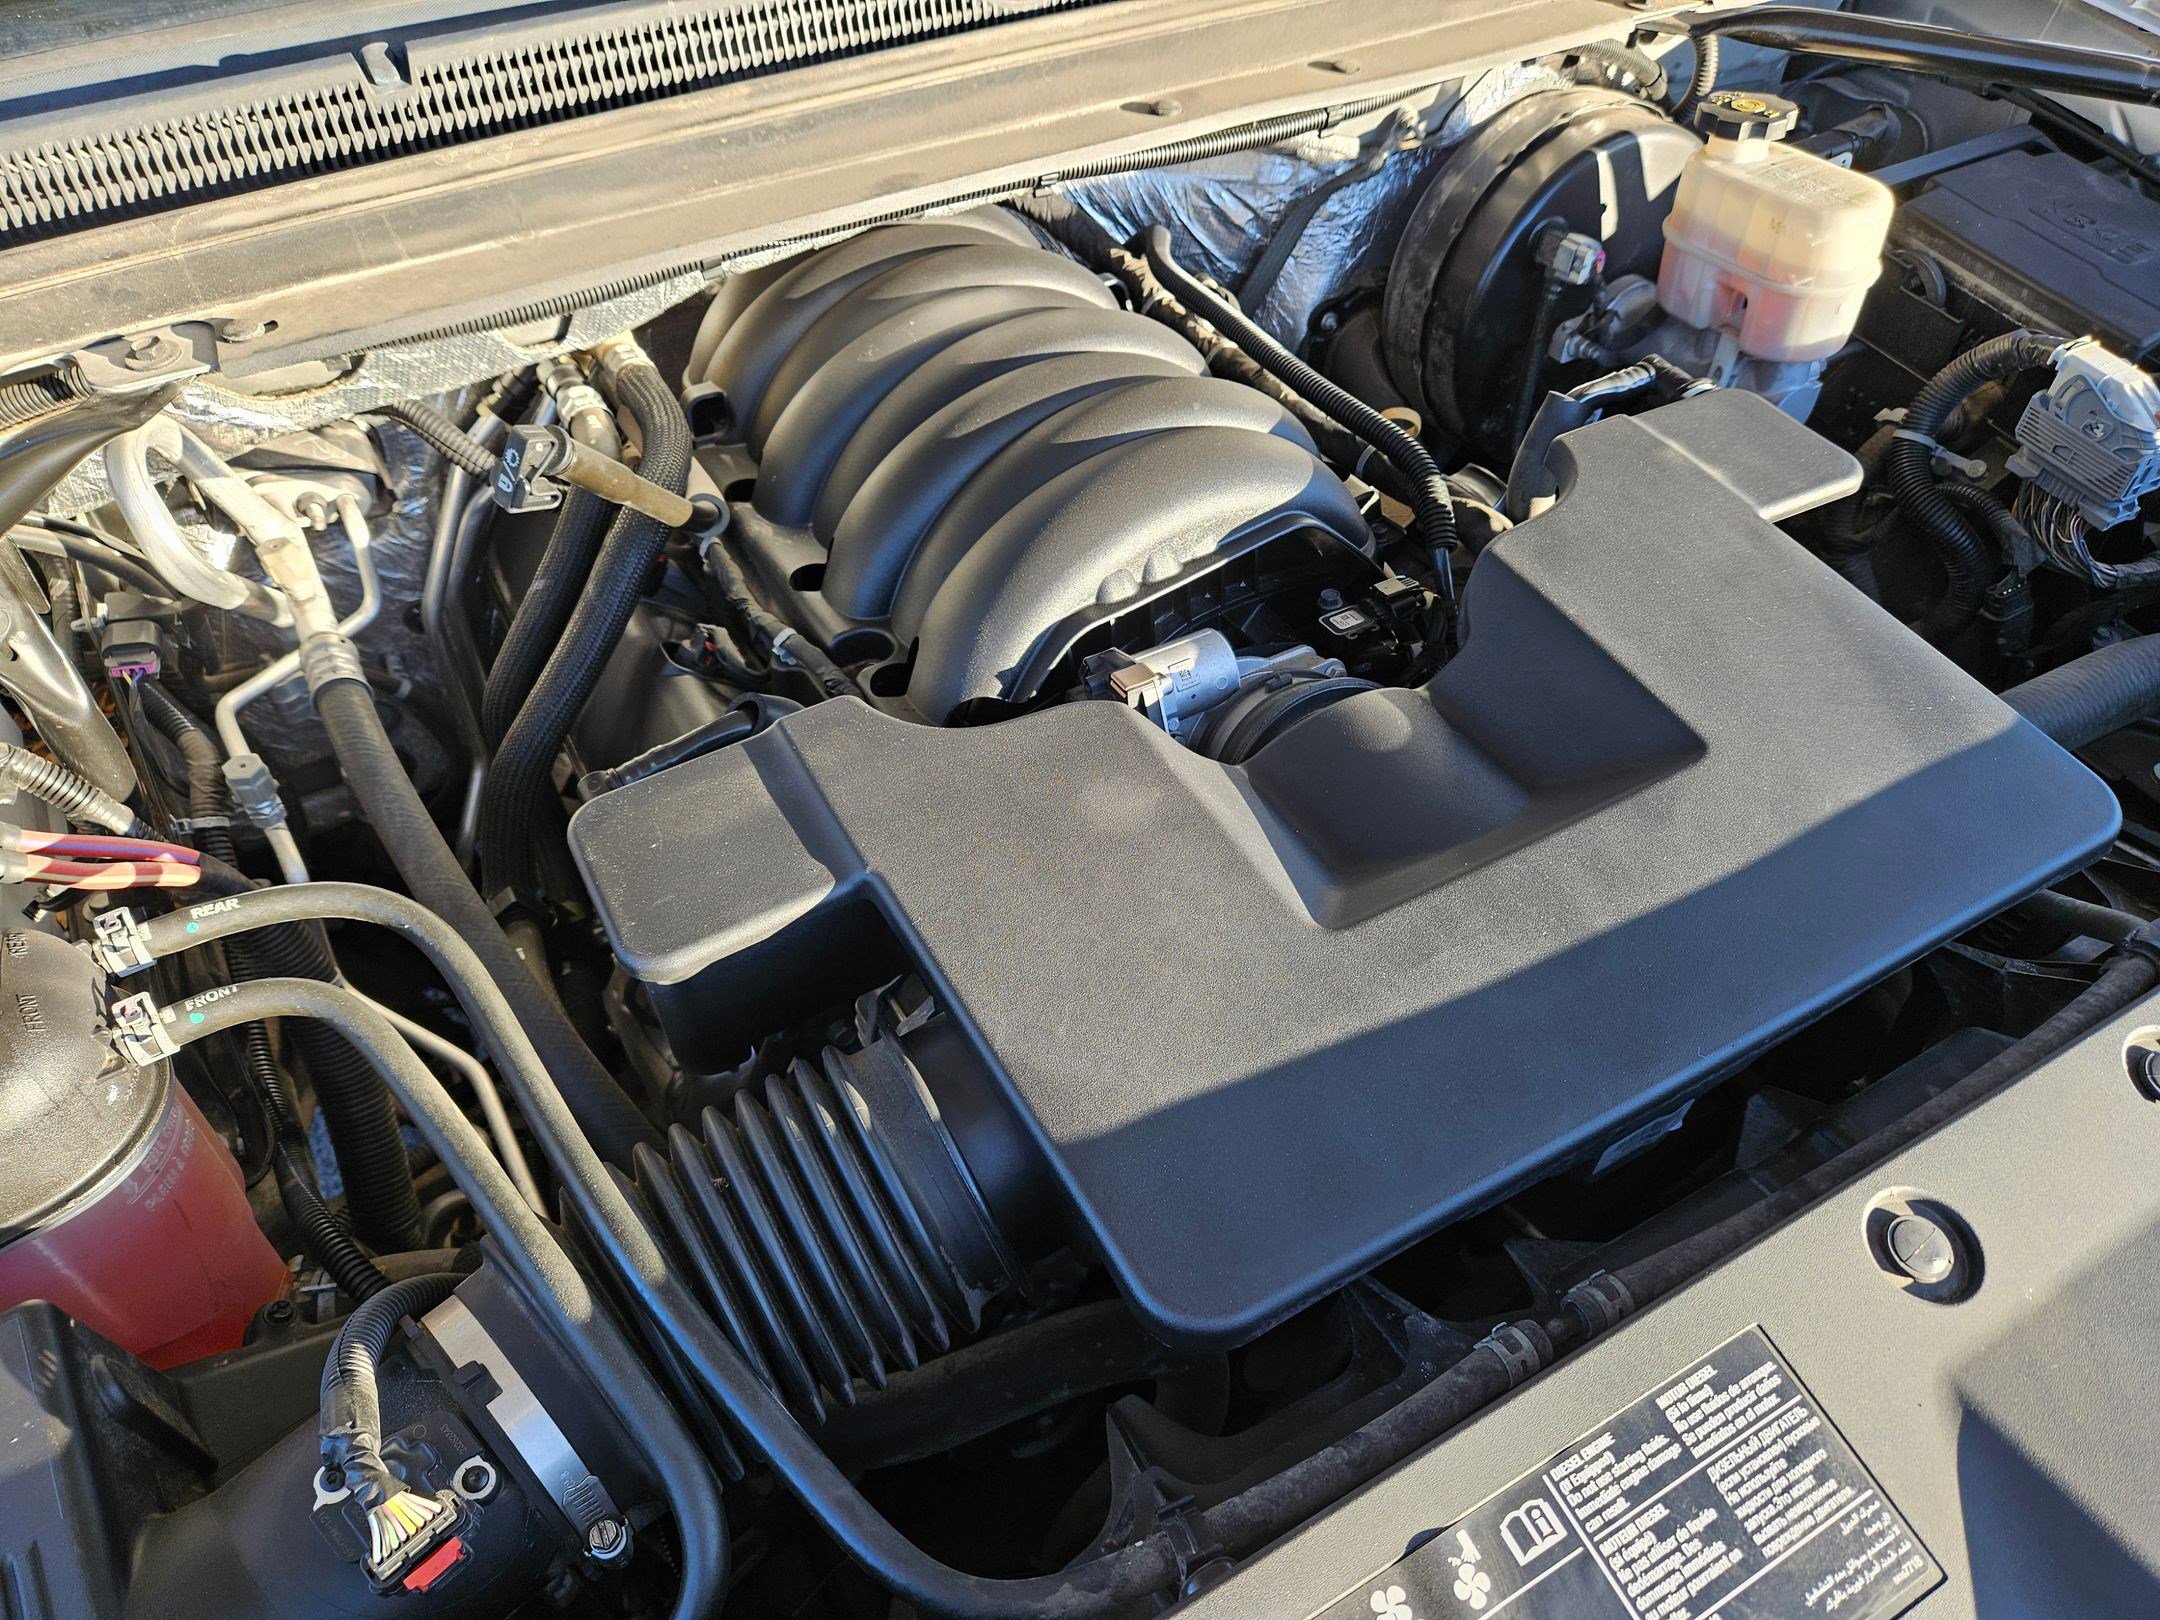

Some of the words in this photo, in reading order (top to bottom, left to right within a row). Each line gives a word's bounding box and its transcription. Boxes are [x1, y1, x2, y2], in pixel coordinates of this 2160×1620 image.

[189, 897, 242, 920] REAR
[16, 993, 47, 1033] FRONT
[184, 984, 239, 1012] FRONT
[1655, 1381, 1689, 1409] MOTOR
[1684, 1364, 1718, 1390] DIESEL
[1672, 1419, 1689, 1434] No
[1686, 1408, 1704, 1425] use
[1727, 1383, 1741, 1397] de
[1738, 1360, 1777, 1390] arranque.
[1676, 1401, 1689, 1413] lo
[1685, 1383, 1714, 1407] tiene)
[1681, 1431, 1697, 1446] Se
[1694, 1411, 1726, 1440] pueden
[1723, 1389, 1757, 1420] producir
[1755, 1374, 1781, 1396] daños
[1689, 1422, 1736, 1459] inmediatos
[1734, 1415, 1747, 1429] en
[1745, 1407, 1756, 1421] el
[1752, 1392, 1780, 1416] motor.
[1706, 1434, 1762, 1483] ДИЗЕЛЬНЫЙ
[1757, 1405, 1809, 1447] ДВИГАТЕЛЬ
[1549, 1453, 1585, 1481] DIESEL
[1579, 1431, 1615, 1461] ENGINE
[1558, 1477, 1573, 1495] (If
[1569, 1450, 1615, 1486] Equipped)
[1566, 1491, 1583, 1507] Do
[1580, 1479, 1599, 1498] not
[1595, 1471, 1613, 1488] use
[1610, 1449, 1646, 1477] starting
[1640, 1434, 1670, 1456] fluids.
[1574, 1480, 1622, 1520] Immediate
[1619, 1464, 1649, 1490] engine
[1646, 1442, 1681, 1471] damage
[1715, 1471, 1741, 1495] (если
[1737, 1437, 1787, 1481] установлен)
[1723, 1491, 1740, 1506] Не
[1737, 1457, 1788, 1498] используйте
[1770, 1475, 1788, 1495] для
[1785, 1448, 1827, 1482] холодного
[1752, 1516, 1787, 1545] вызвать
[1784, 1478, 1838, 1522] немедленное
[1789, 1474, 1815, 1499] может
[1584, 1515, 1604, 1533] can
[1601, 1496, 1630, 1521] result.
[1598, 1522, 1639, 1557] MOTEUR
[1634, 1502, 1669, 1532] DIESEL
[1761, 1514, 1816, 1558] повреждение
[1812, 1485, 1856, 1523] двигателя.
[1608, 1551, 1625, 1572] (si
[1621, 1530, 1660, 1561] équipé)
[1616, 1567, 1633, 1584] Ne
[1630, 1555, 1651, 1577] pas
[1644, 1534, 1678, 1563] utiliser
[1675, 1527, 1690, 1543] de
[1685, 1507, 1717, 1534] liquide
[1680, 1537, 1702, 1557] Des
[1635, 1567, 1684, 1611] dommages
[1677, 1540, 1726, 1578] immédiats
[1645, 1609, 1660, 1620] au
[1656, 1586, 1689, 1616] moteur
[1686, 1554, 1732, 1597] pourraient
[1728, 1548, 1743, 1563] en
